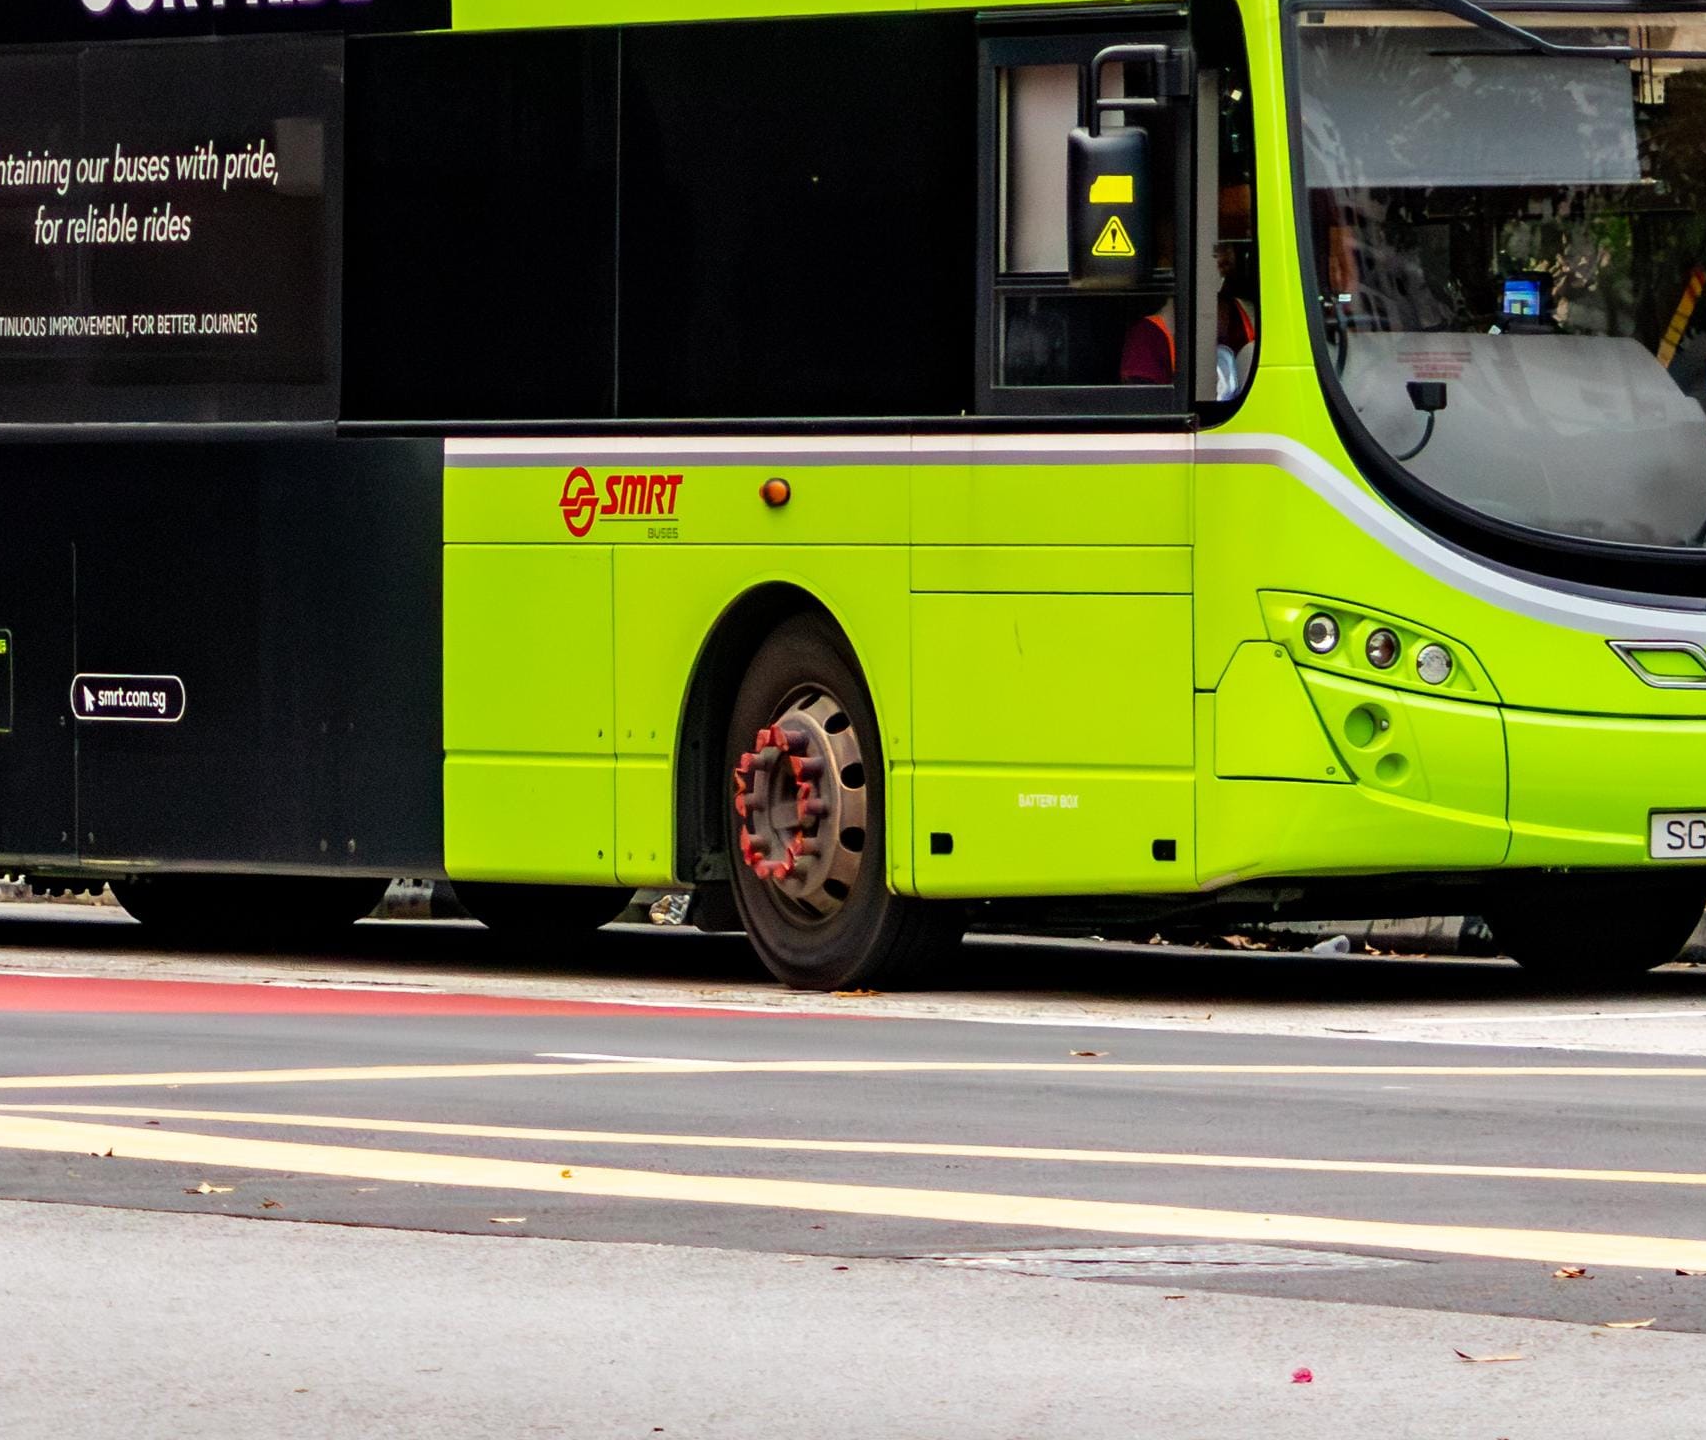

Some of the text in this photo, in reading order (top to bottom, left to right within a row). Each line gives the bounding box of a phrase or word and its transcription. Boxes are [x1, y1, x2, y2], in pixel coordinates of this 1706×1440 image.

[76, 157, 110, 183] our
[113, 143, 170, 183] buses
[176, 140, 219, 181] with
[223, 138, 280, 191] pride,
[34, 202, 192, 244] for reliable rides
[49, 314, 130, 339] IMPROVEMENT,
[132, 314, 155, 335] FOR
[157, 313, 197, 335] BETTER
[197, 312, 258, 335] JOURNEYS
[600, 474, 684, 515] SMRT
[647, 527, 680, 540] BUSES
[97, 687, 166, 714] smrt.com.sg
[1018, 793, 1079, 809] BATTERY BOX
